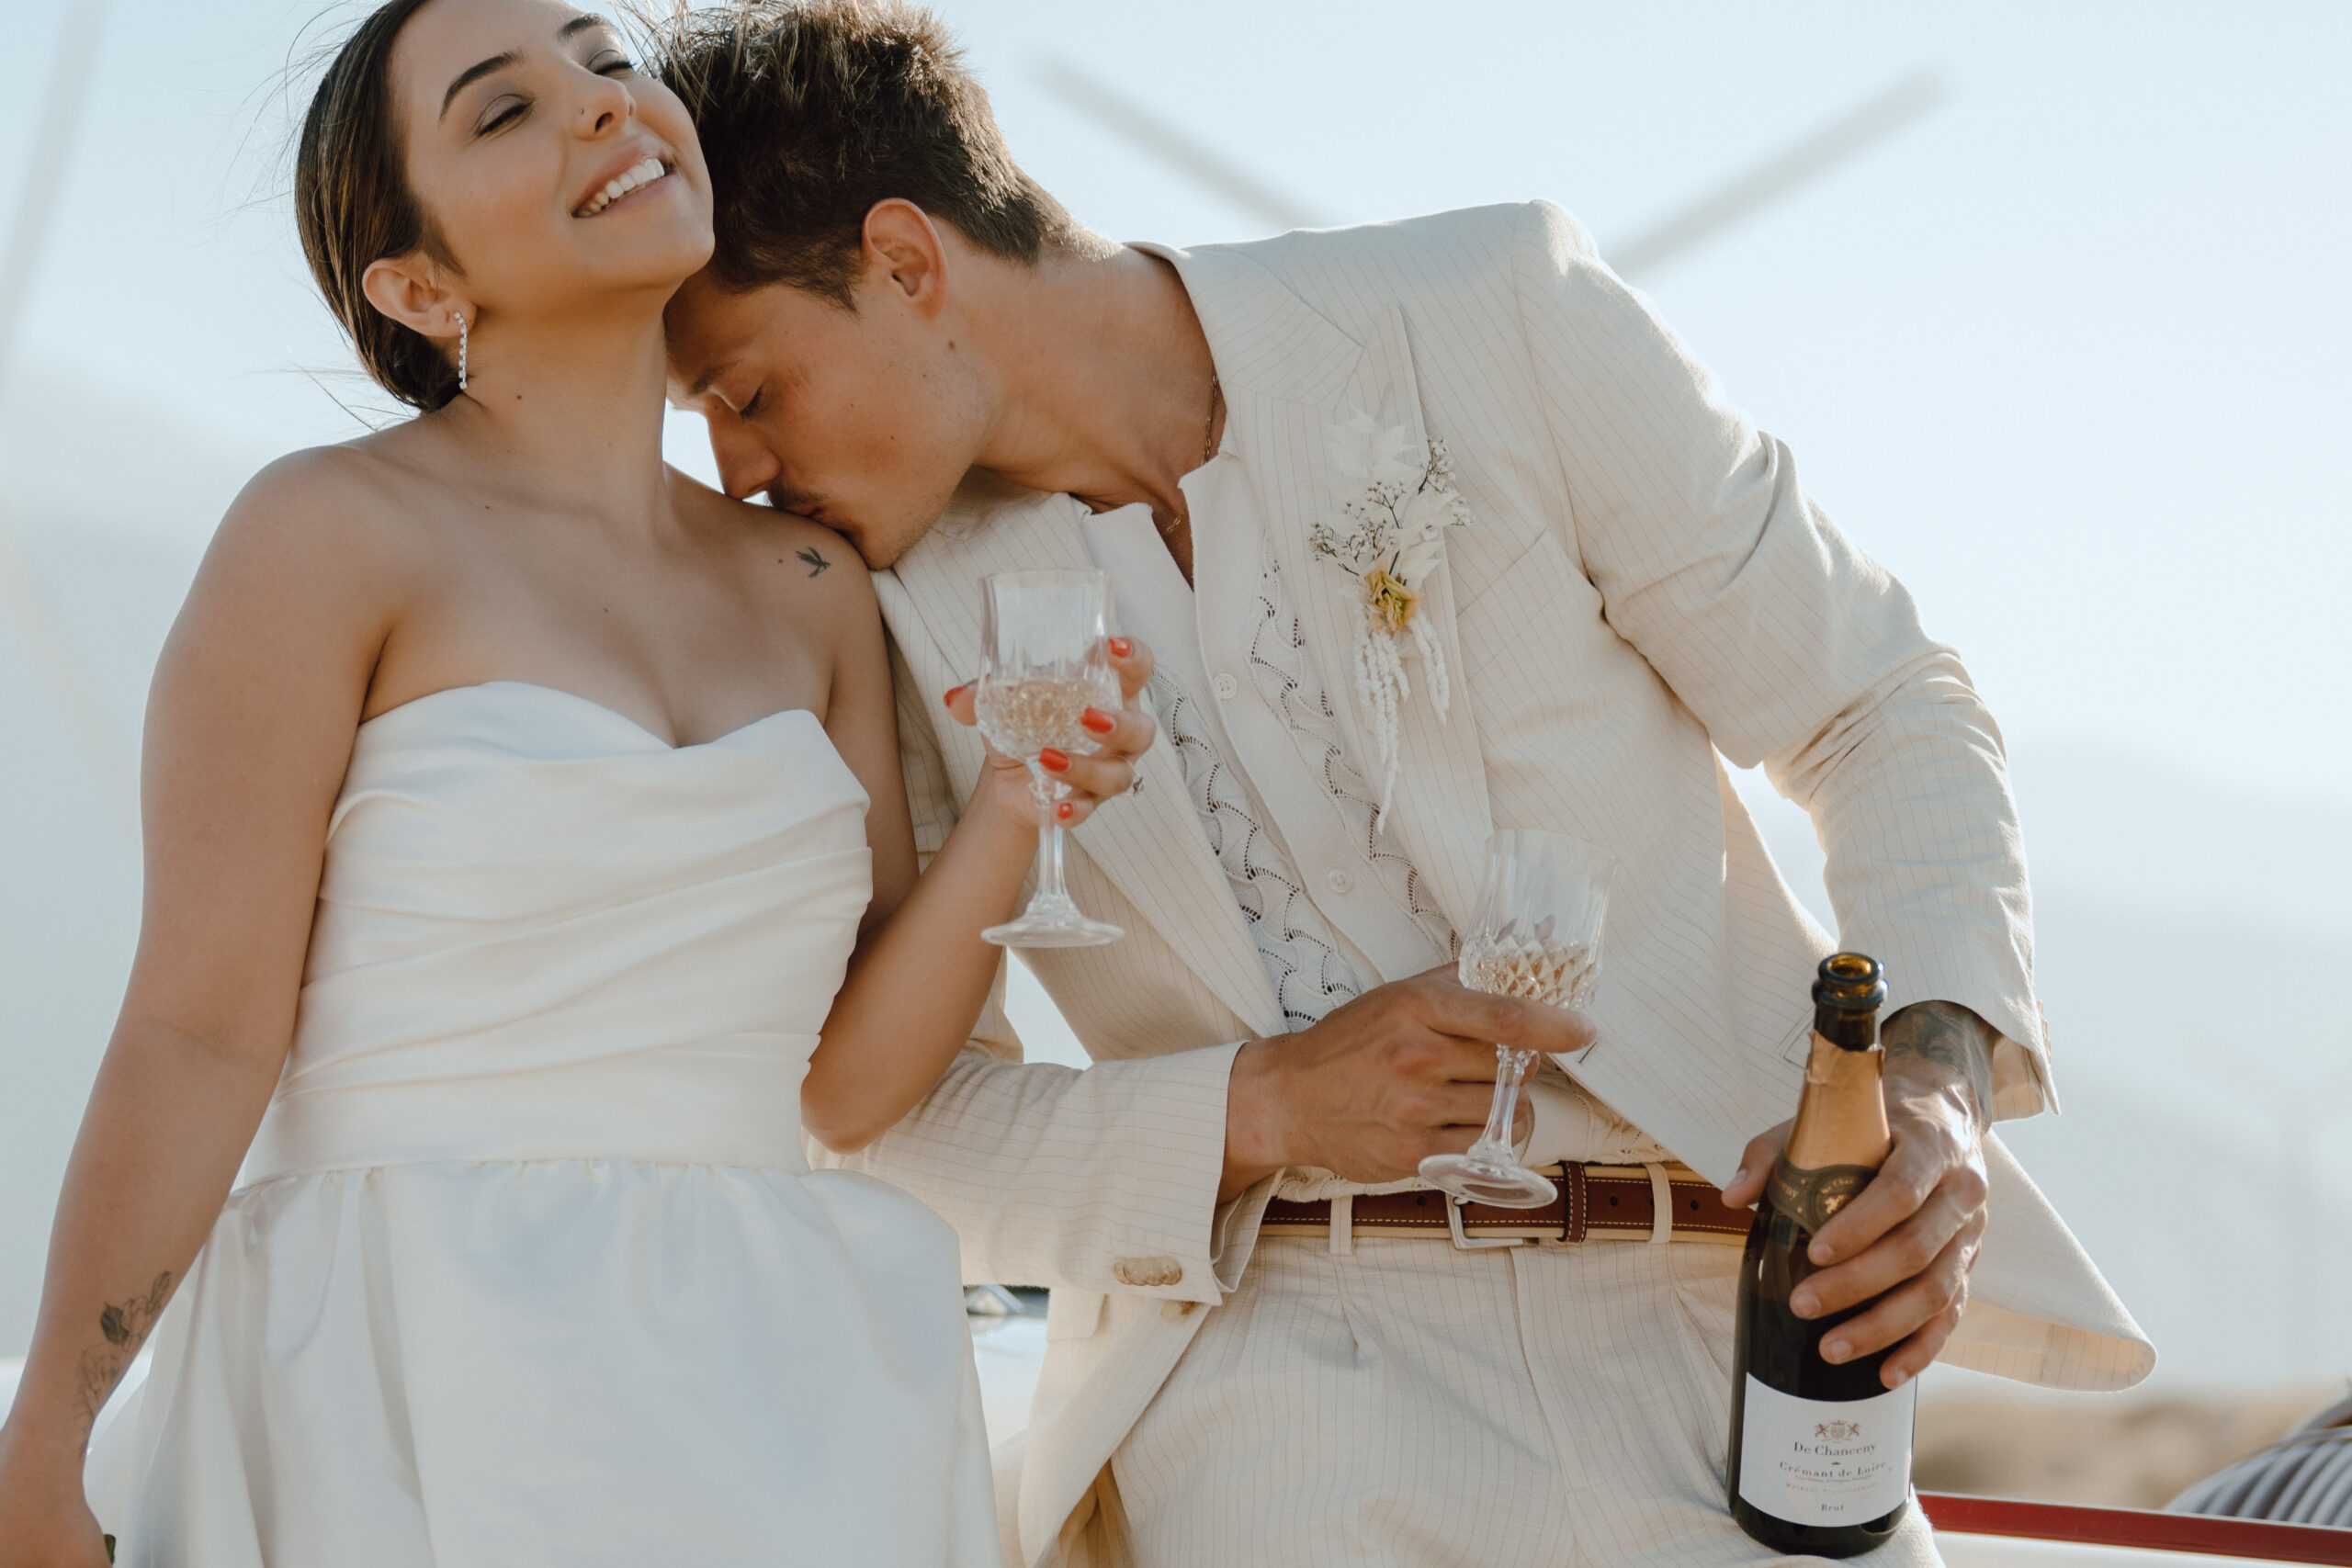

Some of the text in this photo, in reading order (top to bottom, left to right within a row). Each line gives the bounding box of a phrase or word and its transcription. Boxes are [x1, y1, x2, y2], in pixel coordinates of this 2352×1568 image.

[1794, 1441, 1875, 1456] De Chanceny
[1780, 1461, 1885, 1477] Crémant de Loire
